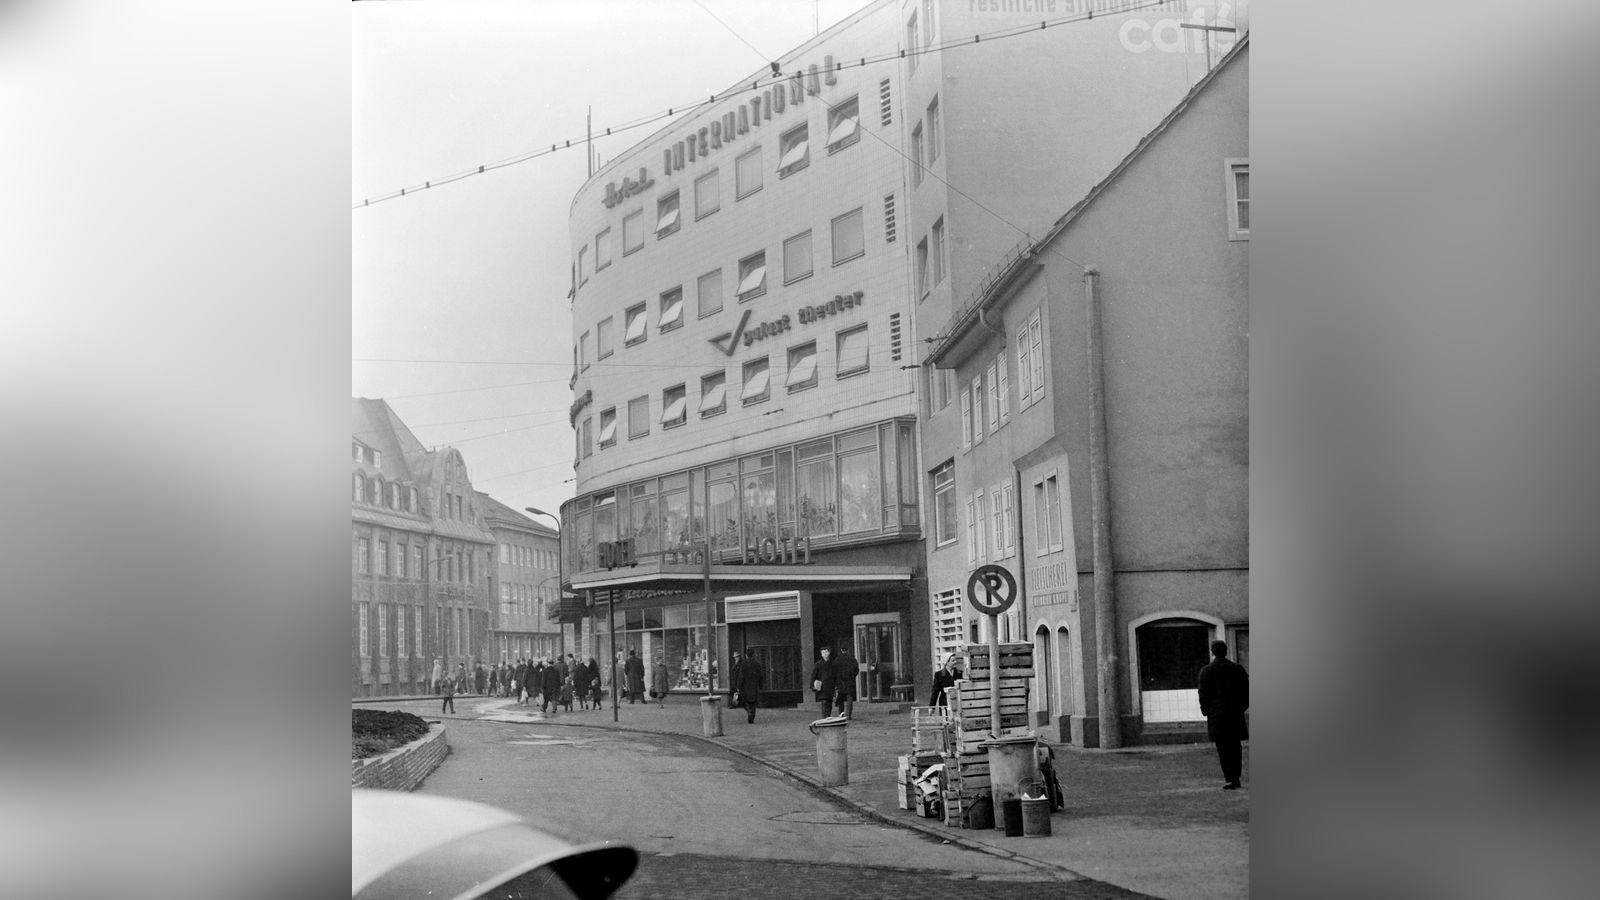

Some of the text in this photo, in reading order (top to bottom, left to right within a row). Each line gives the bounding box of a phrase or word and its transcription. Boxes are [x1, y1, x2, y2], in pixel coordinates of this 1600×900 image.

[1119, 2, 1238, 54] café
[663, 54, 838, 176] INTERNATIONAL
[798, 290, 864, 324] theater
[742, 536, 817, 565] HOTEL
